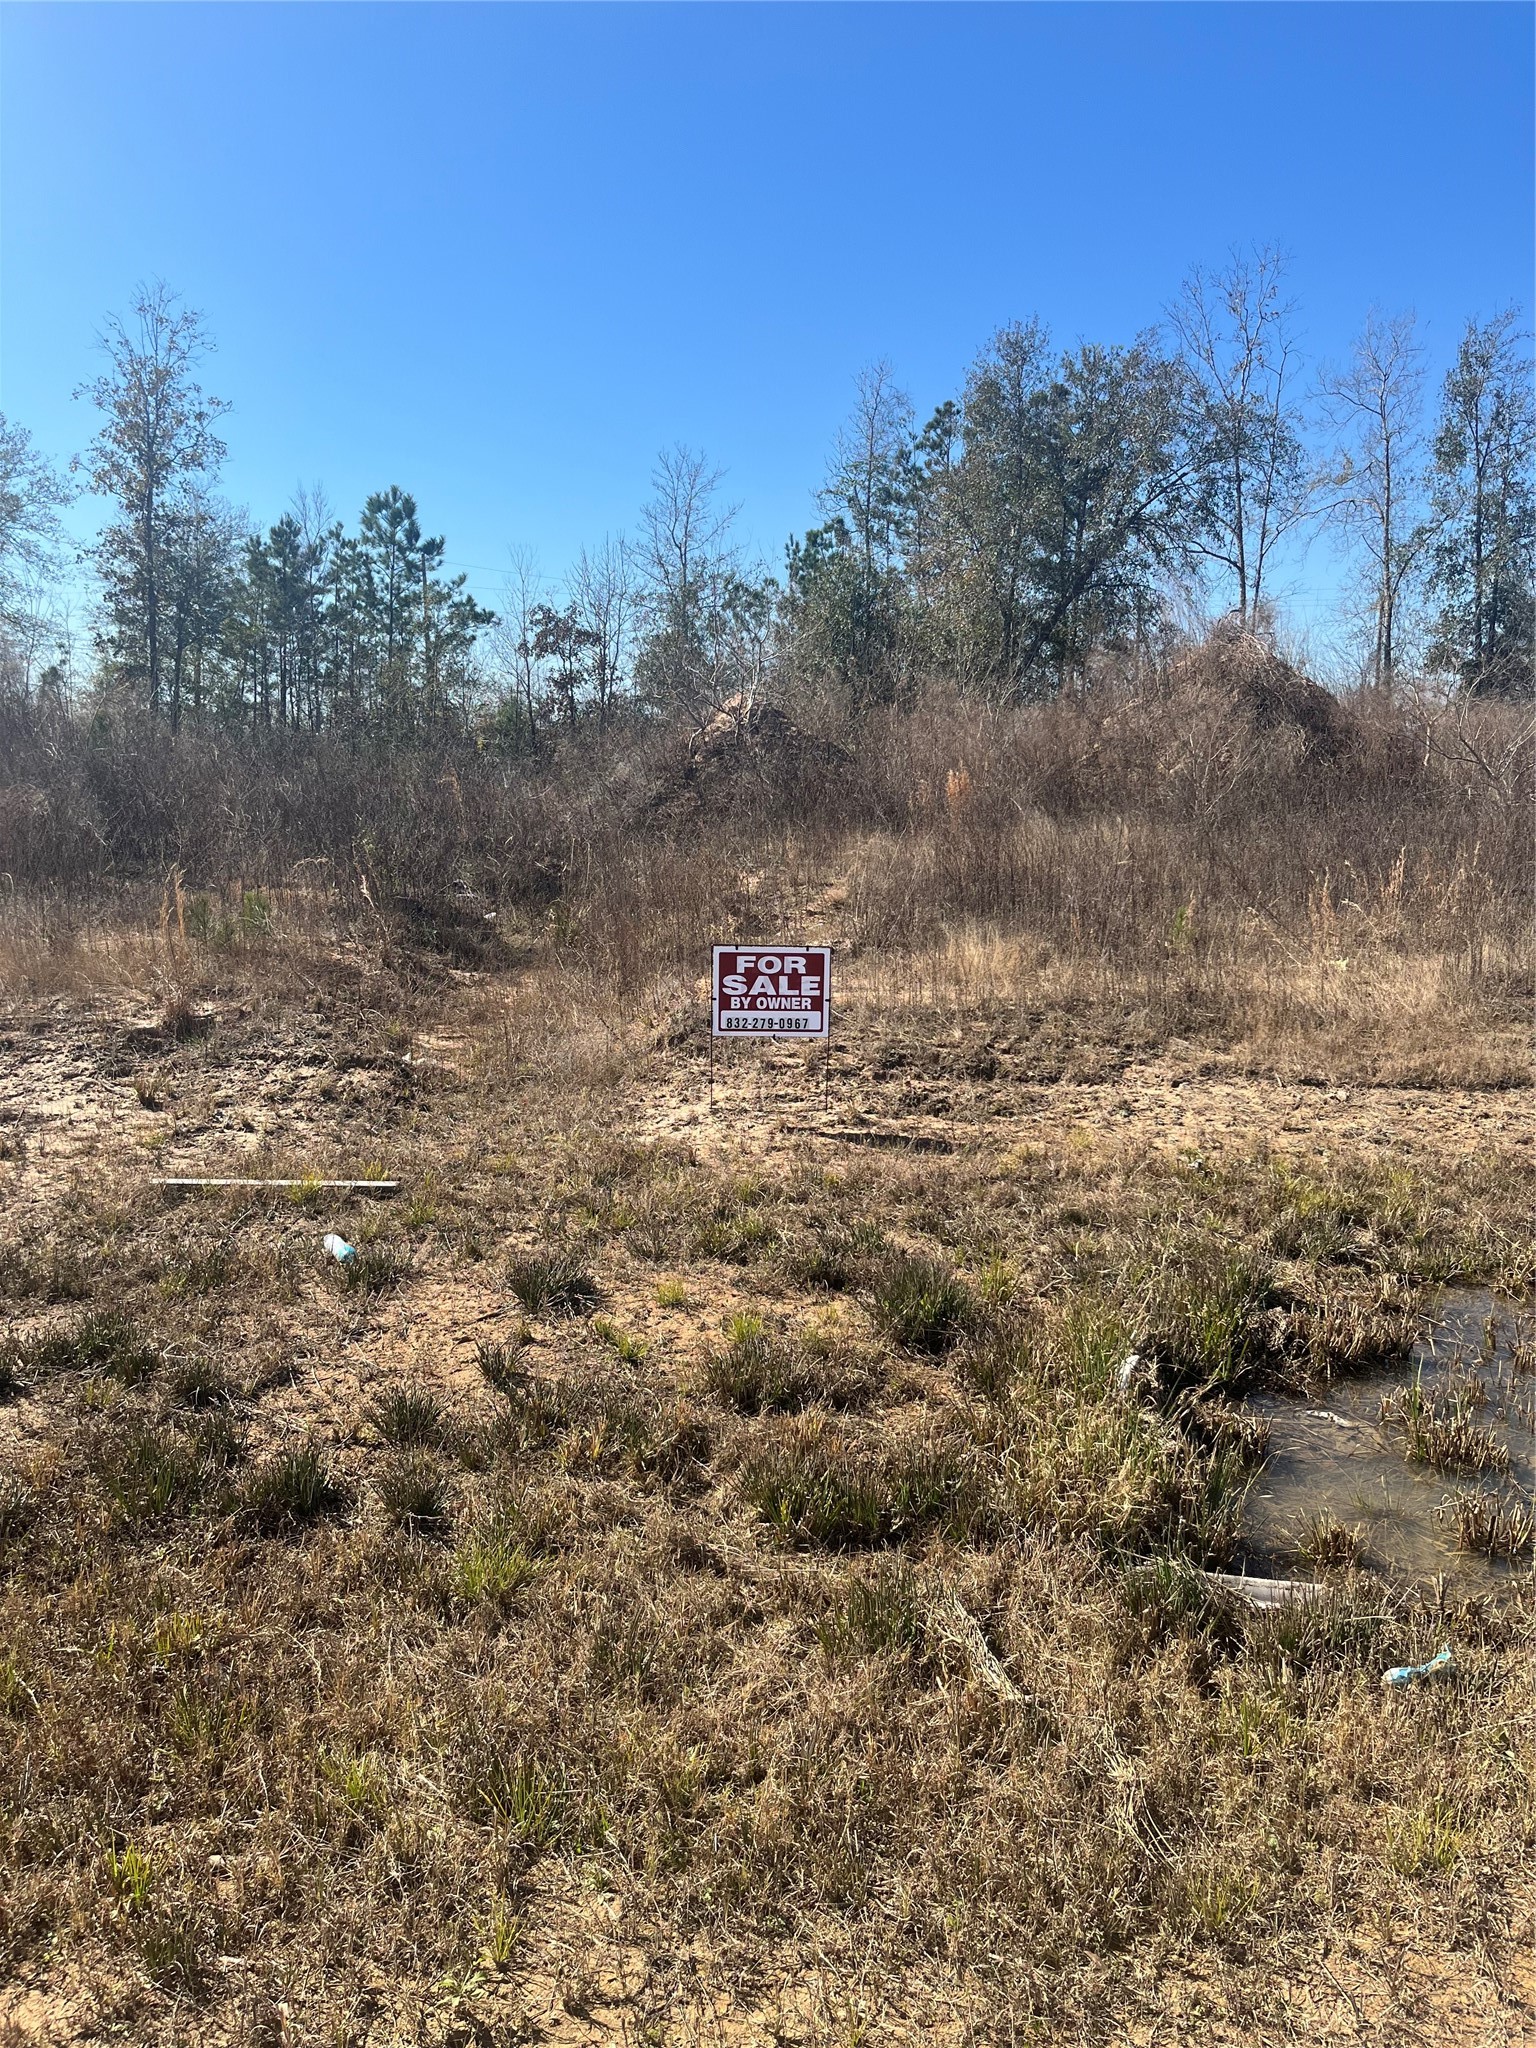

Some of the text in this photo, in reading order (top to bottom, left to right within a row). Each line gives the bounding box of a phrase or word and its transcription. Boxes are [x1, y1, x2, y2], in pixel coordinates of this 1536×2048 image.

[736, 955, 807, 974] FOR
[722, 975, 820, 996] SALE
[730, 997, 811, 1010] BY OWNER
[726, 1017, 809, 1029] 832-279-0967
